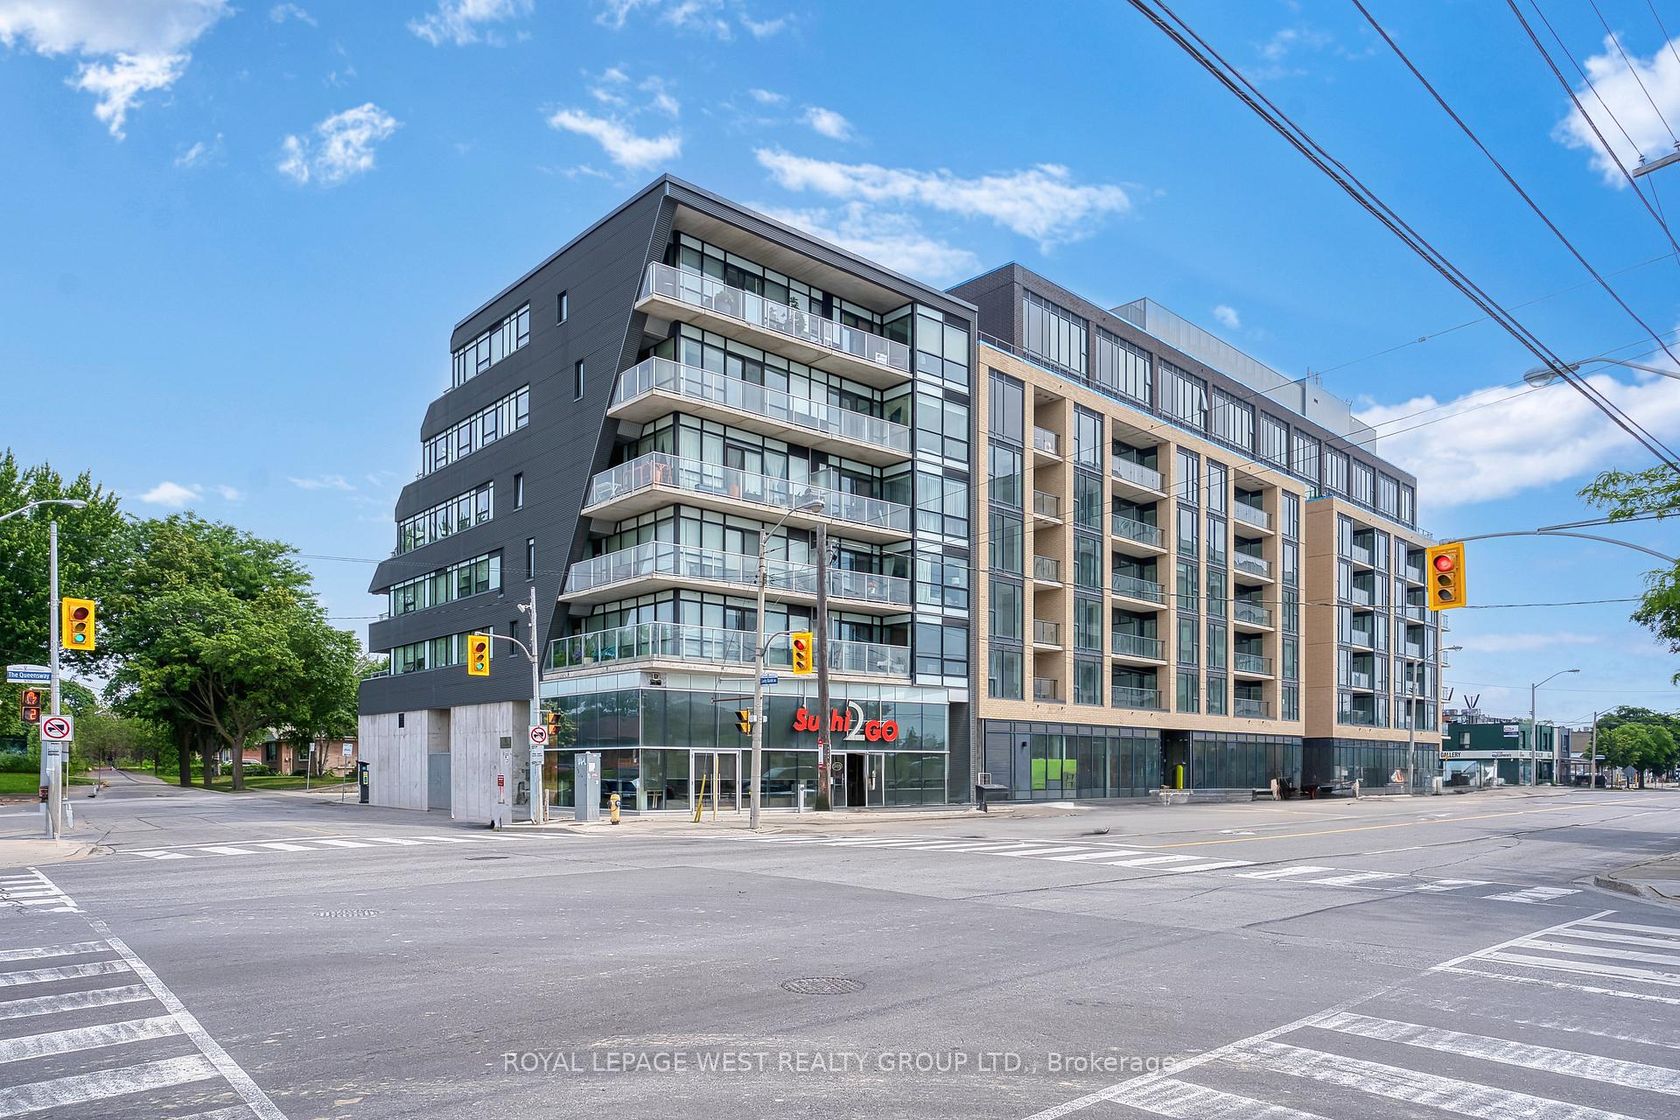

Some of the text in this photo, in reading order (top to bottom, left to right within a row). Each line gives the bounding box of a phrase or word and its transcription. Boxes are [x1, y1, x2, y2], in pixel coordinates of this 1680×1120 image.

[19, 672, 50, 680] Queensway
[30, 709, 37, 720] 2
[793, 708, 852, 732] Suhi
